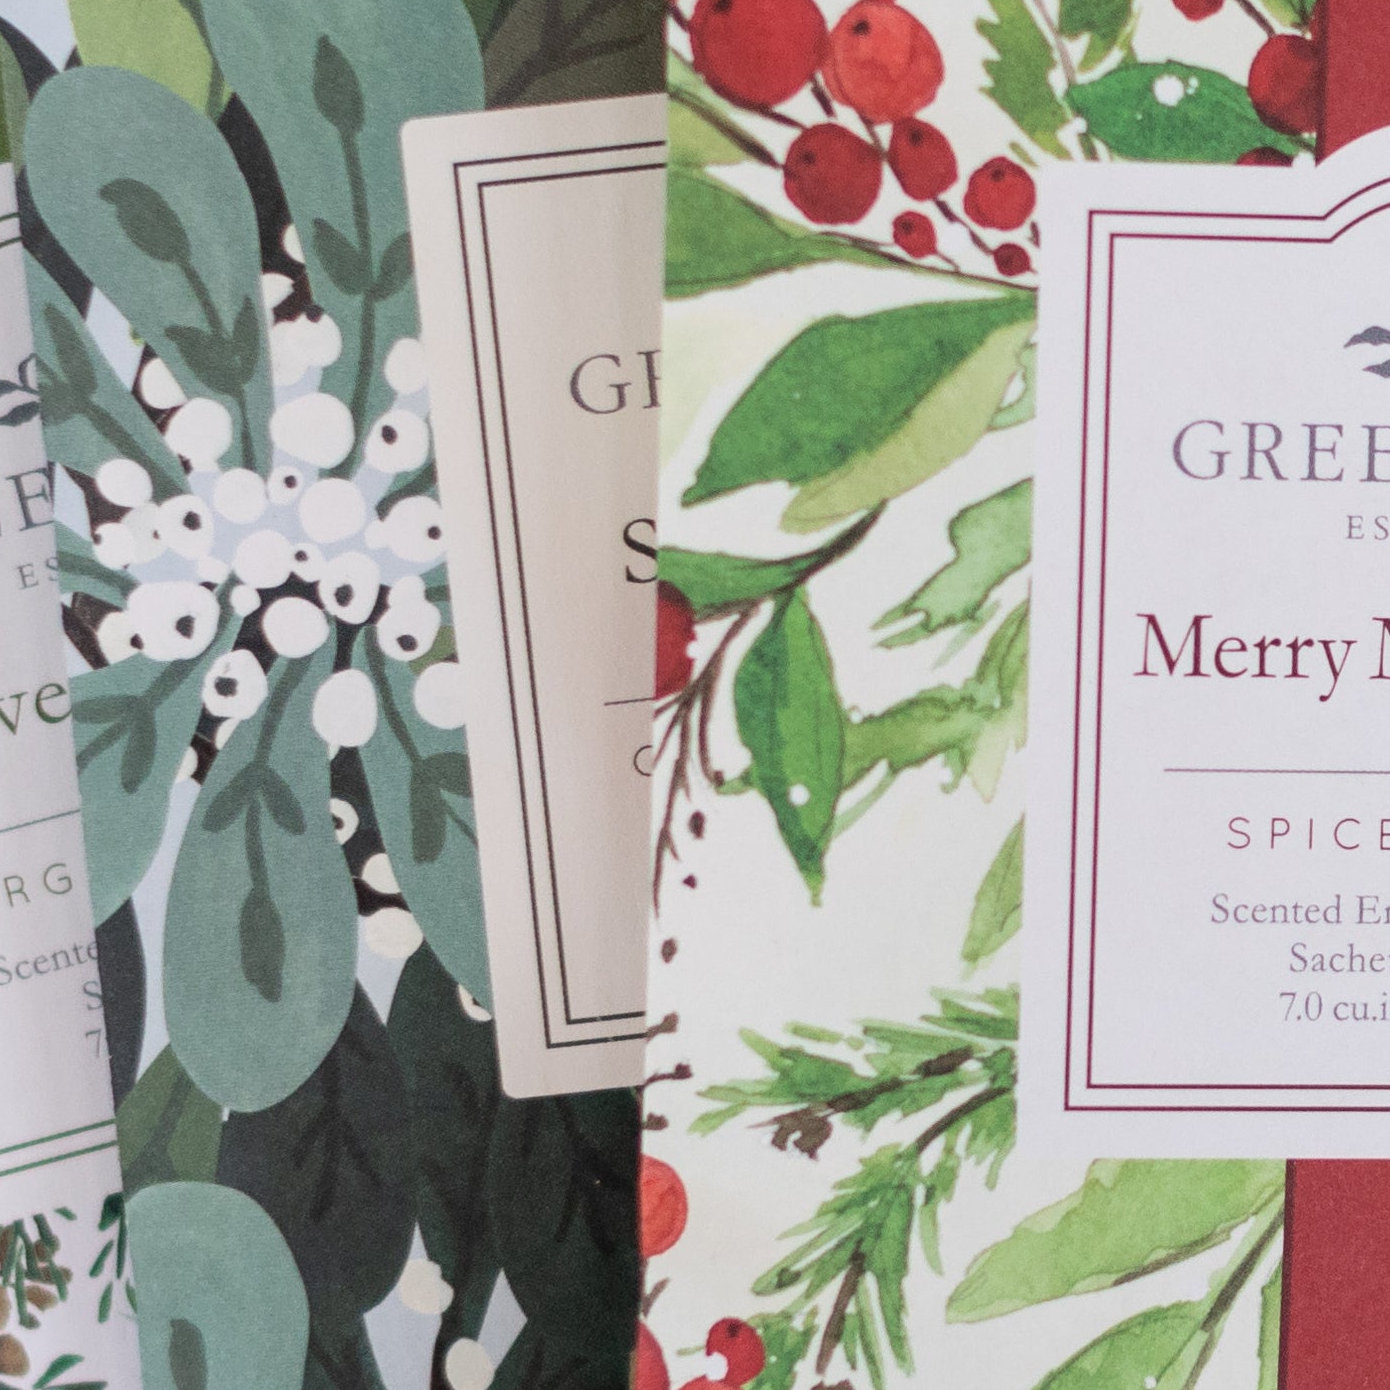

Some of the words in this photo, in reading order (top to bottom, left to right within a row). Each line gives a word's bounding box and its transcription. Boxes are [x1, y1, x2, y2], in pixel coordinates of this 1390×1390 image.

[1132, 612, 1358, 704] Merry
[1210, 893, 1343, 927] Scented
[1278, 991, 1324, 1023] 7.0
